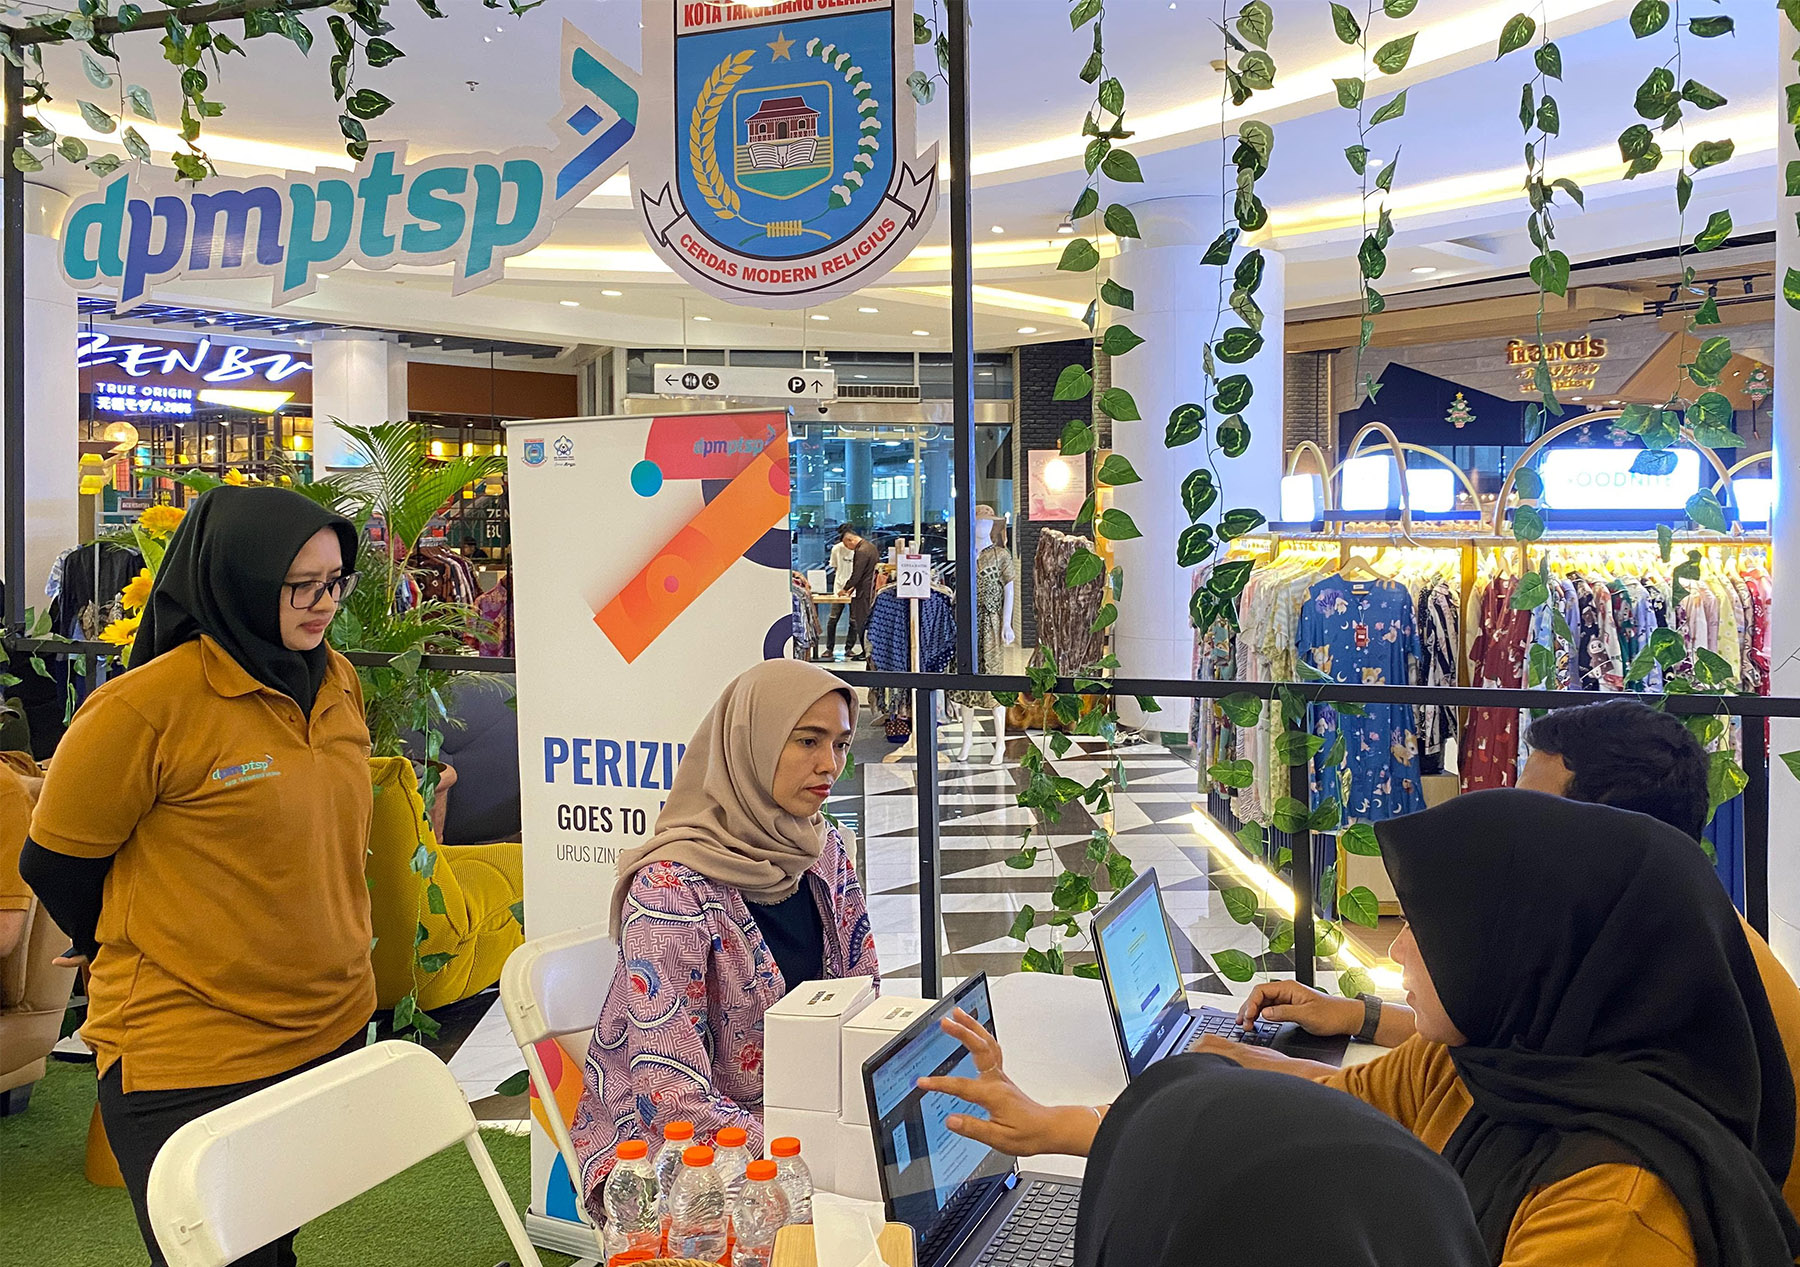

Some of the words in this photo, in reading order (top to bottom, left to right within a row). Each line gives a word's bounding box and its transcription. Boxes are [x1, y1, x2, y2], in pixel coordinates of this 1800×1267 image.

[684, 5, 722, 27] KOTA
[63, 151, 544, 303] dpmptsp
[680, 233, 738, 277] CERDAS
[742, 265, 817, 283] MODERN
[821, 217, 896, 276] RELIGIUS
[96, 382, 137, 396] TRUE
[141, 386, 193, 400] ORIGIN
[693, 436, 764, 459] dpmptsp
[544, 736, 688, 791] PERIZI
[557, 803, 614, 834] GOES
[619, 807, 647, 836] TO
[556, 843, 591, 863] URUS
[593, 846, 617, 865] IZIN
